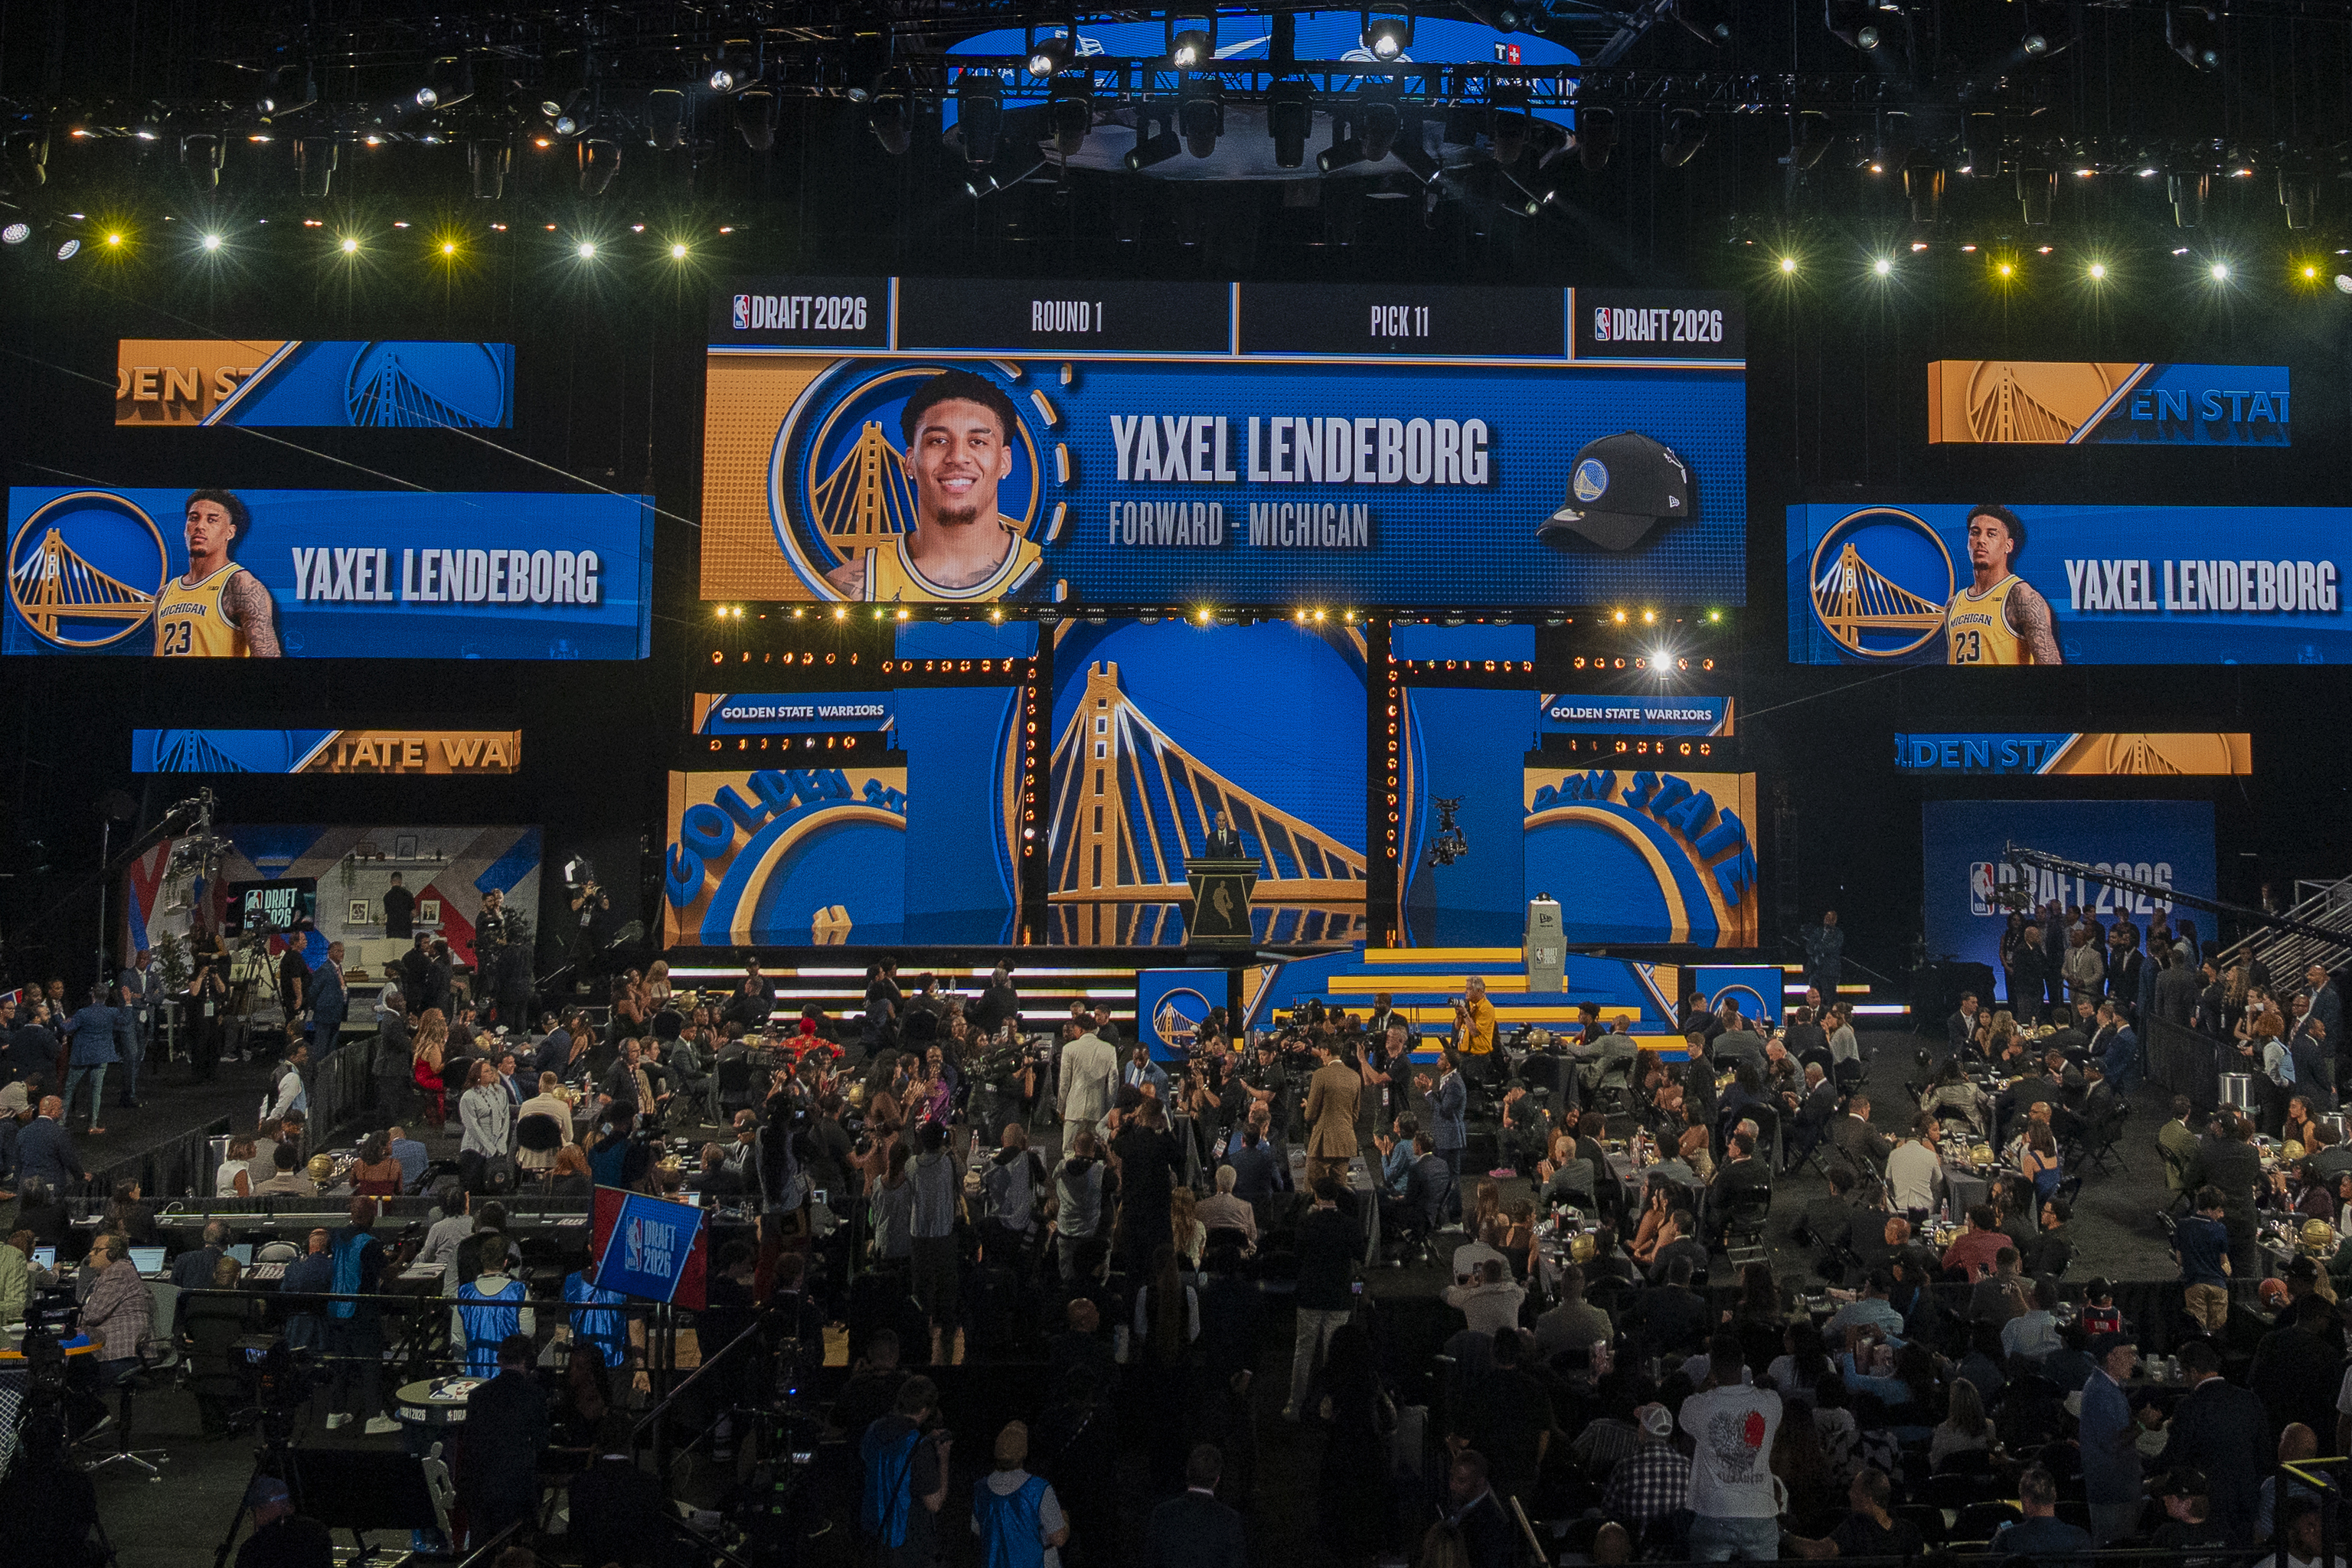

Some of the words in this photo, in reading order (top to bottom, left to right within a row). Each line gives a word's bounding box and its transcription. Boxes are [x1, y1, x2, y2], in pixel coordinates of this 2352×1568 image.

[751, 296, 812, 329] DRAFT
[815, 296, 867, 330] 2026
[1032, 301, 1089, 332] ROUND
[1095, 302, 1102, 332] 1
[1370, 305, 1409, 336] PICK
[1415, 306, 1429, 336] 11
[1612, 309, 1671, 341] DRAFT
[1673, 309, 1722, 341] 2026
[1109, 415, 1236, 482] YAXEL
[1248, 416, 1488, 485] LENDEBORG
[1109, 501, 1223, 546] FORWARD
[1250, 502, 1368, 547] MICHIGAN
[292, 547, 393, 601] YAXEL
[403, 548, 599, 603] LENDEBORG
[2064, 560, 2158, 610] YAXEL
[2164, 560, 2337, 611] LENDEBORG
[158, 602, 207, 620] MICHIGAN
[1950, 612, 1993, 629] MICHIGAN
[163, 619, 192, 657] 23
[1955, 629, 1981, 665] 23
[721, 706, 775, 718] GOLDEN
[778, 706, 814, 717] STATE
[818, 704, 884, 717] WARRIORS
[1550, 707, 1602, 719] GOLDEN
[1606, 707, 1640, 720] STATE
[1645, 708, 1712, 720] WARRIORS
[441, 738, 513, 767] WA
[264, 888, 298, 910] DRAFT
[2096, 862, 2173, 915] 2026
[264, 907, 292, 928] 026
[644, 1220, 677, 1252] DRAFT
[643, 1246, 672, 1279] 2026
